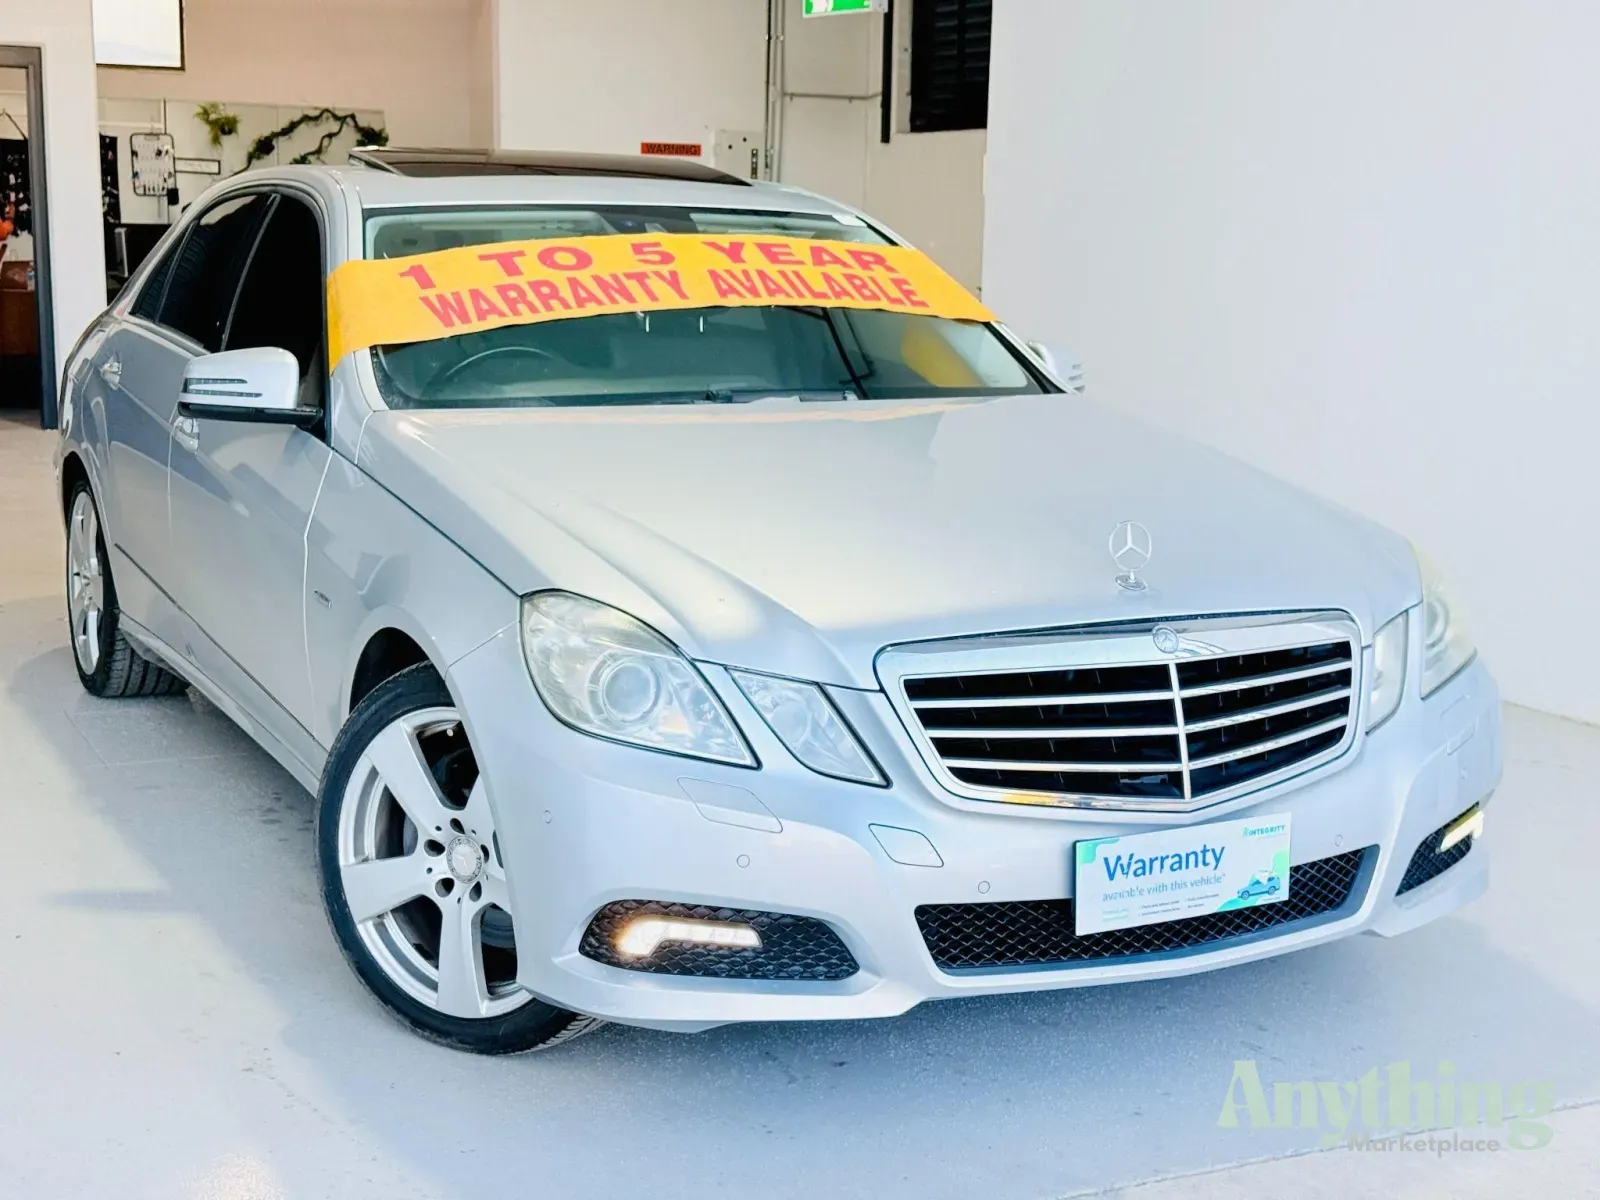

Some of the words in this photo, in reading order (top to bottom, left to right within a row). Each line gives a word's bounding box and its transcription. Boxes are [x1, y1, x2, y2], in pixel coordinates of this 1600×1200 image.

[646, 143, 698, 155] WARNING
[399, 264, 437, 290] 1
[478, 246, 593, 278] TO
[630, 241, 677, 266] 5
[701, 241, 900, 274] YEAR
[419, 270, 691, 329] WARRANTY
[707, 269, 931, 308] AVAILABLE
[1103, 844, 1226, 882] Warranty
[1147, 882, 1168, 895] with
[1170, 880, 1188, 891] this
